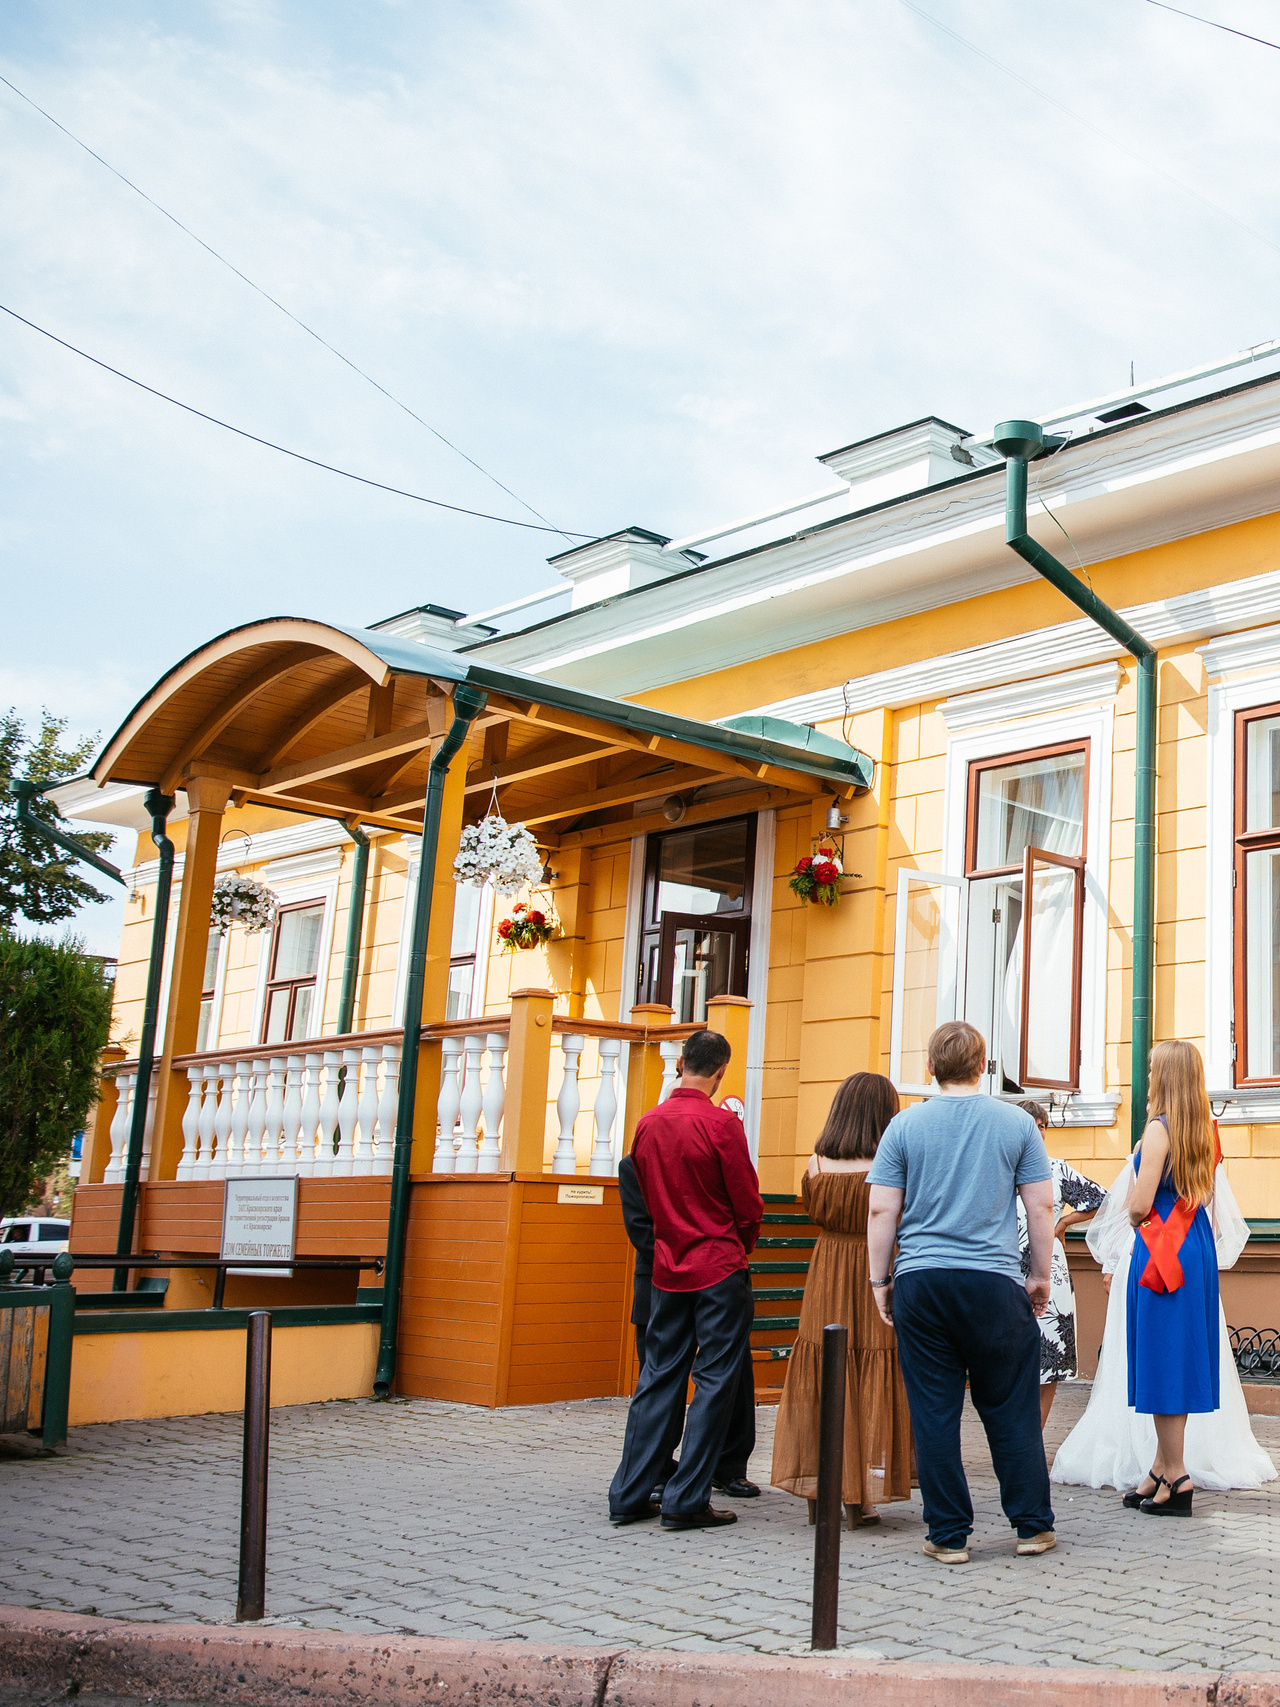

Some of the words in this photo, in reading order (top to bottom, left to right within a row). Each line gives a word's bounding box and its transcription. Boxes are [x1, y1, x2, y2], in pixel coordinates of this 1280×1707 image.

[224, 1242, 236, 1256] ДОМ
[236, 1240, 262, 1256] СЕМЕЙНЫХ
[263, 1243, 291, 1258] ТОРЖЕСТВ
